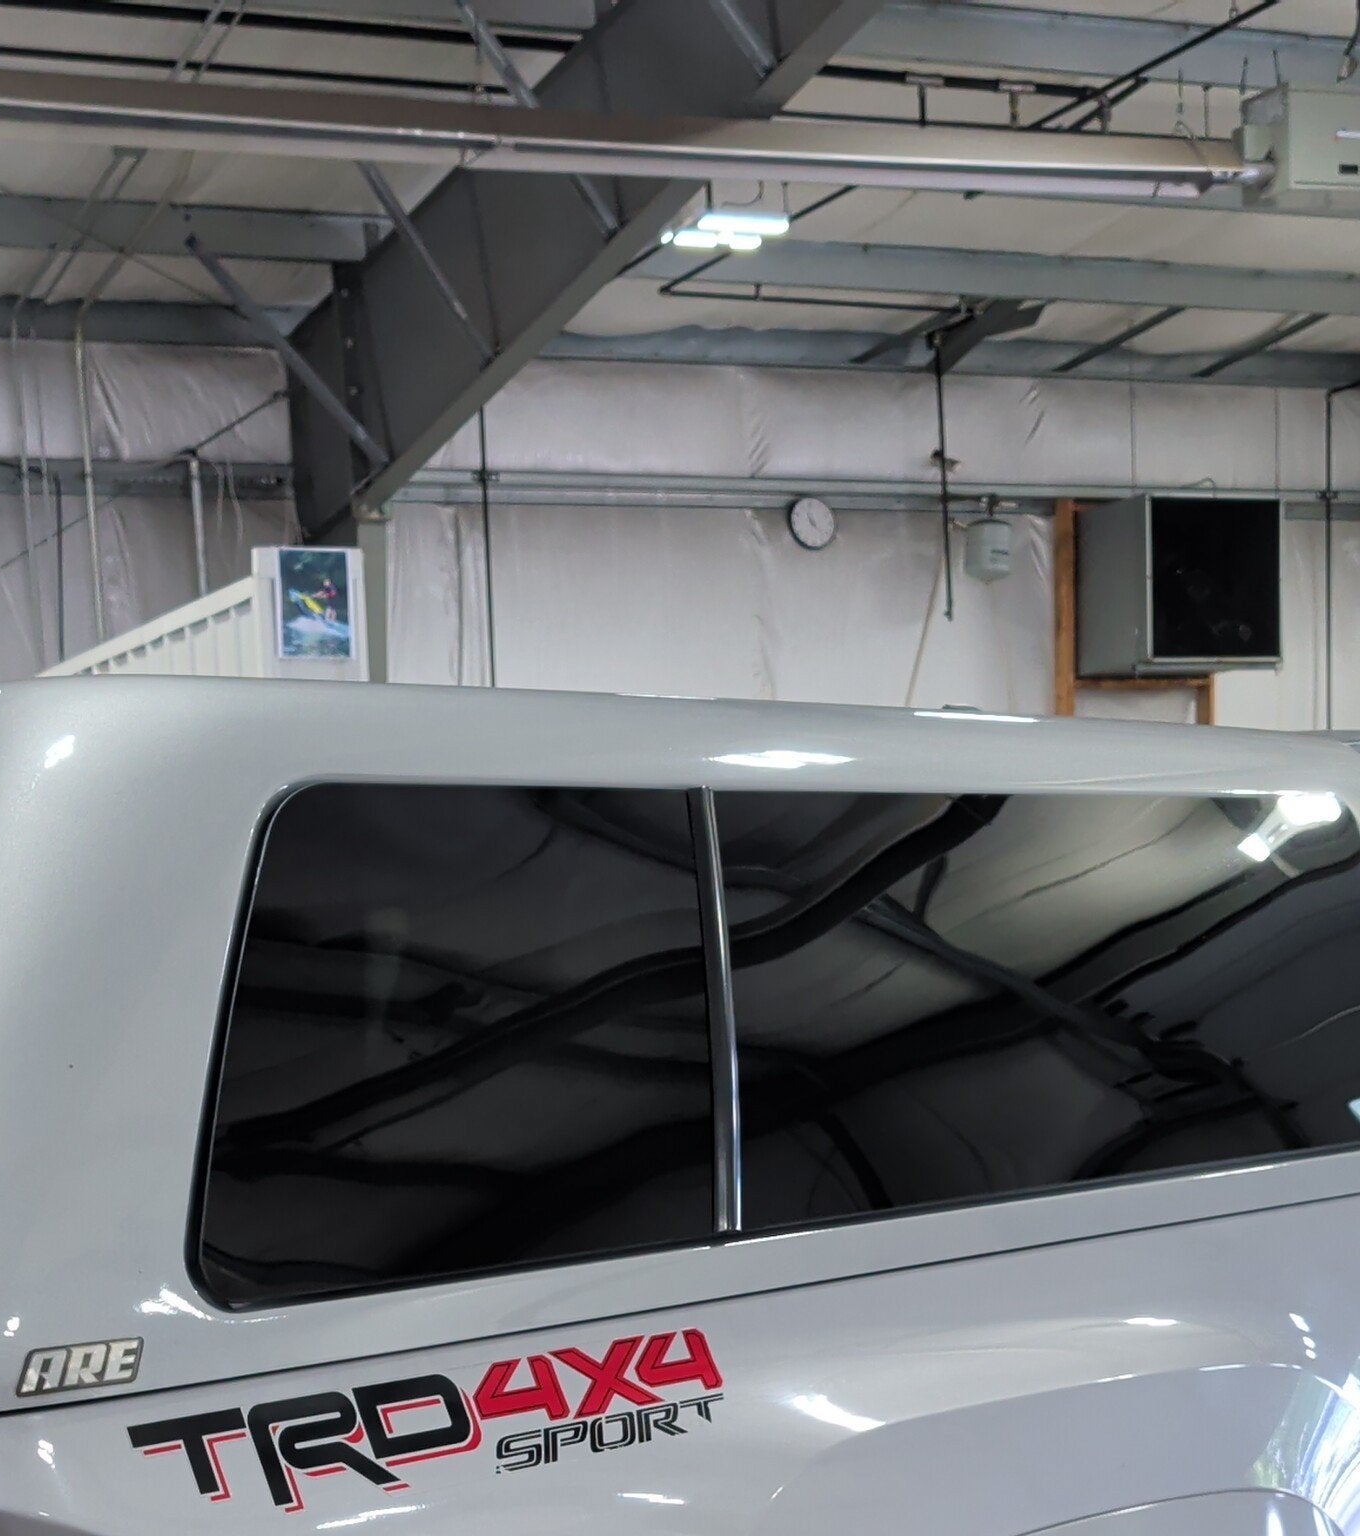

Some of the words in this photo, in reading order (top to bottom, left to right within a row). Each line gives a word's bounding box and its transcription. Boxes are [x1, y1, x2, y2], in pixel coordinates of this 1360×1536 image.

[20, 1336, 140, 1393] ARE
[126, 1373, 483, 1514] TRD
[473, 1327, 724, 1421] 4X4
[495, 1393, 724, 1474] SPORT
